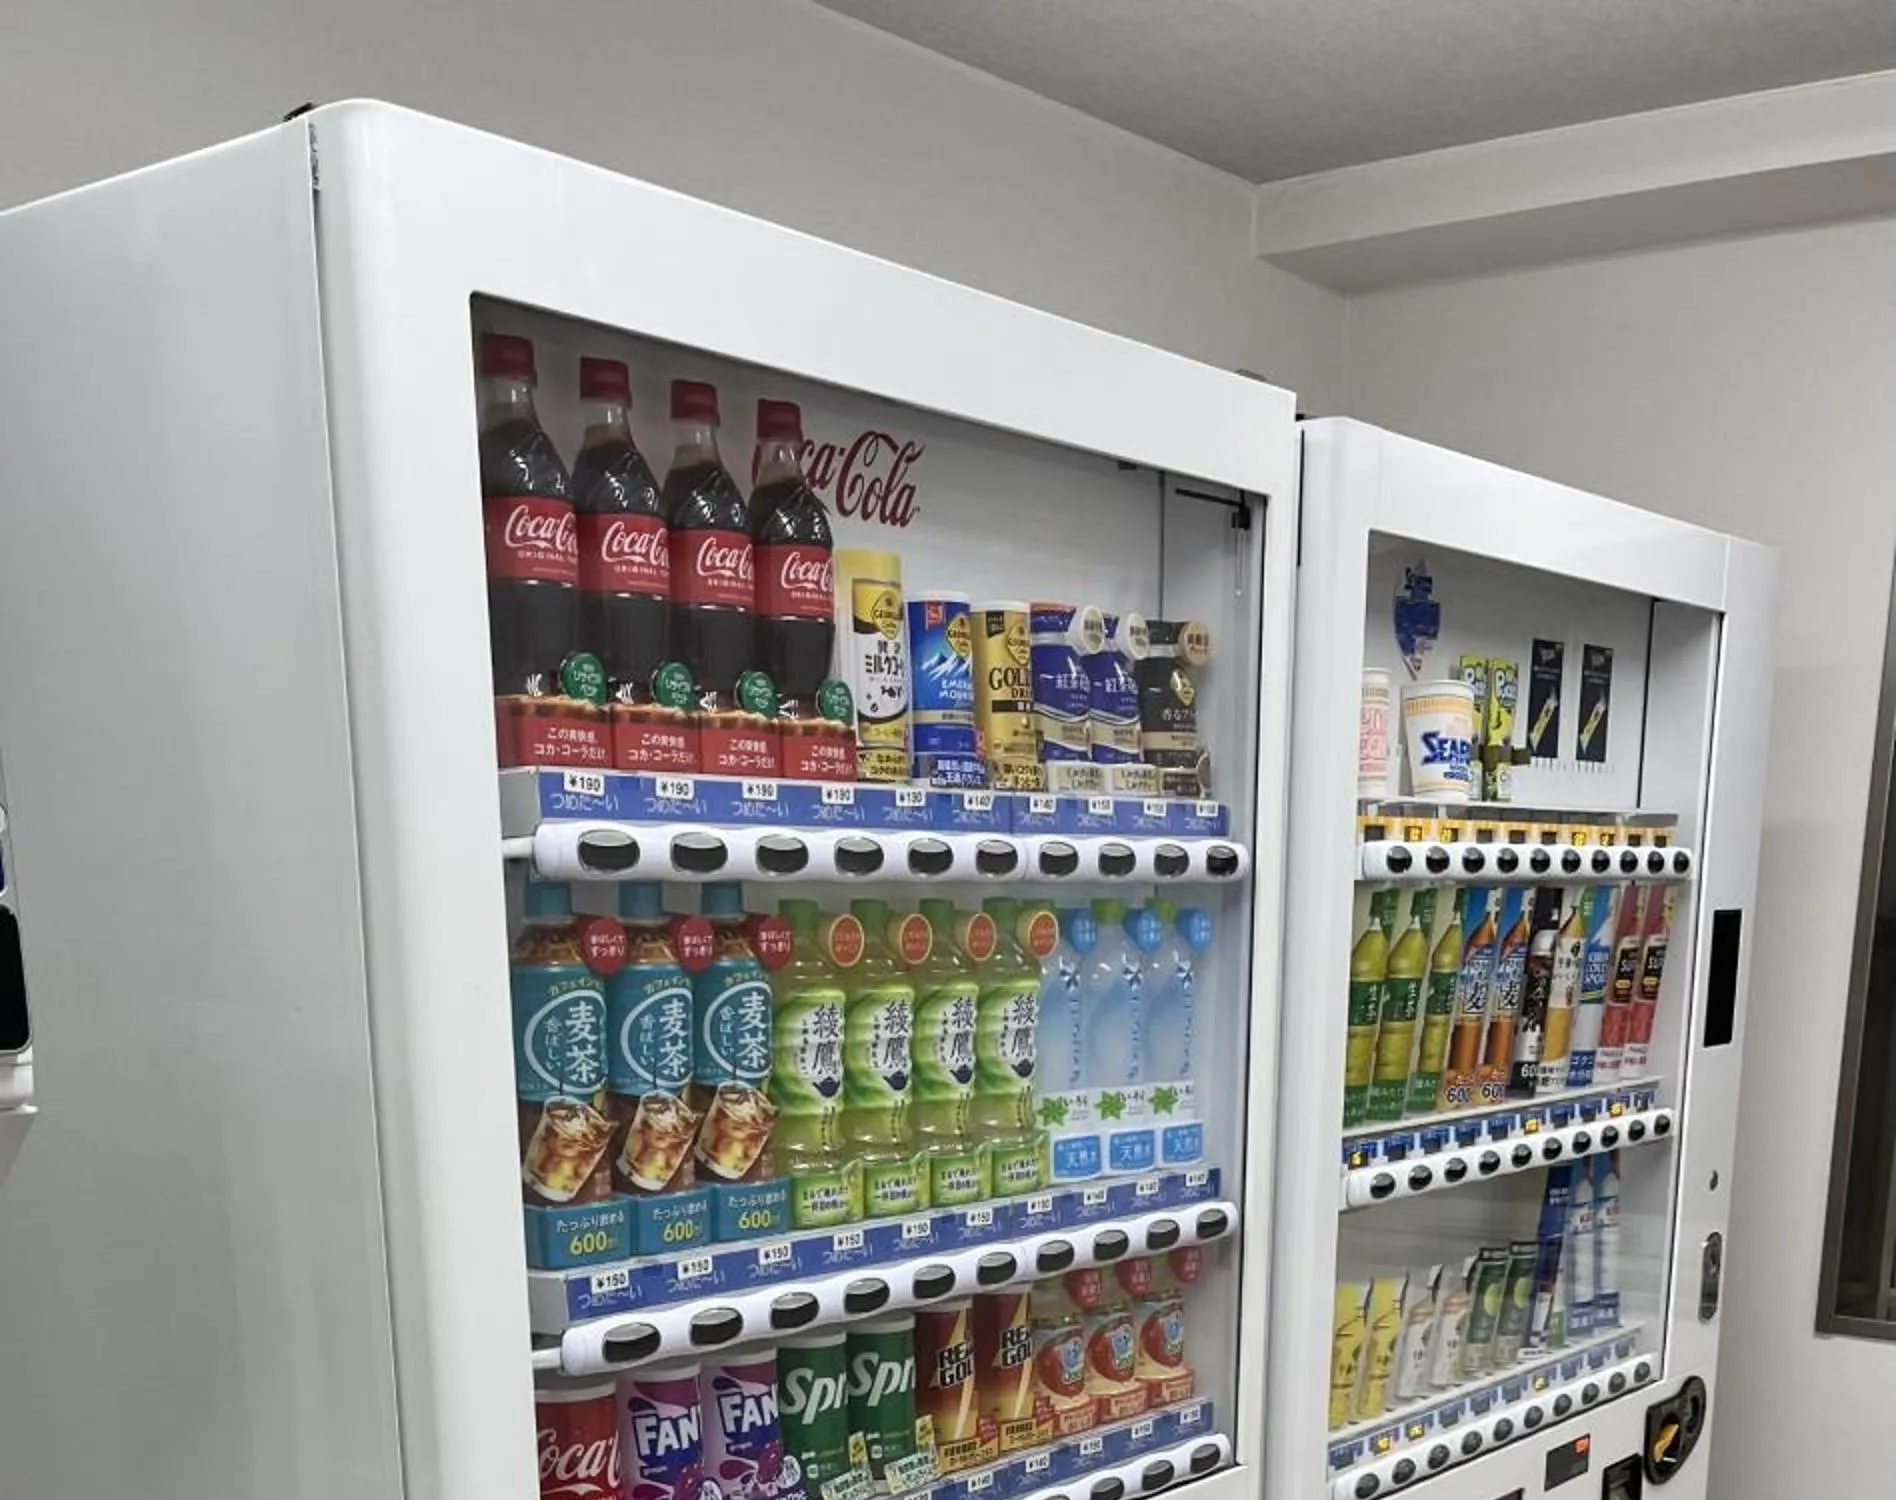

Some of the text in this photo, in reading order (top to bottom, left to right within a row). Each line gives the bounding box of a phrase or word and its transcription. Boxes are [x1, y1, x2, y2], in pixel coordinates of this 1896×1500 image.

[753, 430, 926, 529] ca-Cola
[989, 667, 1030, 691] GOL
[568, 775, 601, 793] ¥190
[661, 781, 690, 796] ¥190
[747, 783, 775, 798] ¥190
[564, 999, 599, 1085] 麦茶
[657, 997, 689, 1079] 麦茶
[737, 991, 768, 1070] 麦茶
[812, 1003, 841, 1076] 綾鷹
[884, 999, 909, 1070] 綾鷹
[951, 996, 974, 1064] 綾鷹
[1011, 992, 1036, 1058] 綾鷹
[763, 1246, 789, 1261] ¥150
[837, 1233, 861, 1248] ¥150
[596, 1272, 627, 1290] ¥150
[682, 1258, 711, 1275] ¥150
[632, 1408, 701, 1457] FAN
[716, 1384, 779, 1434] FAN
